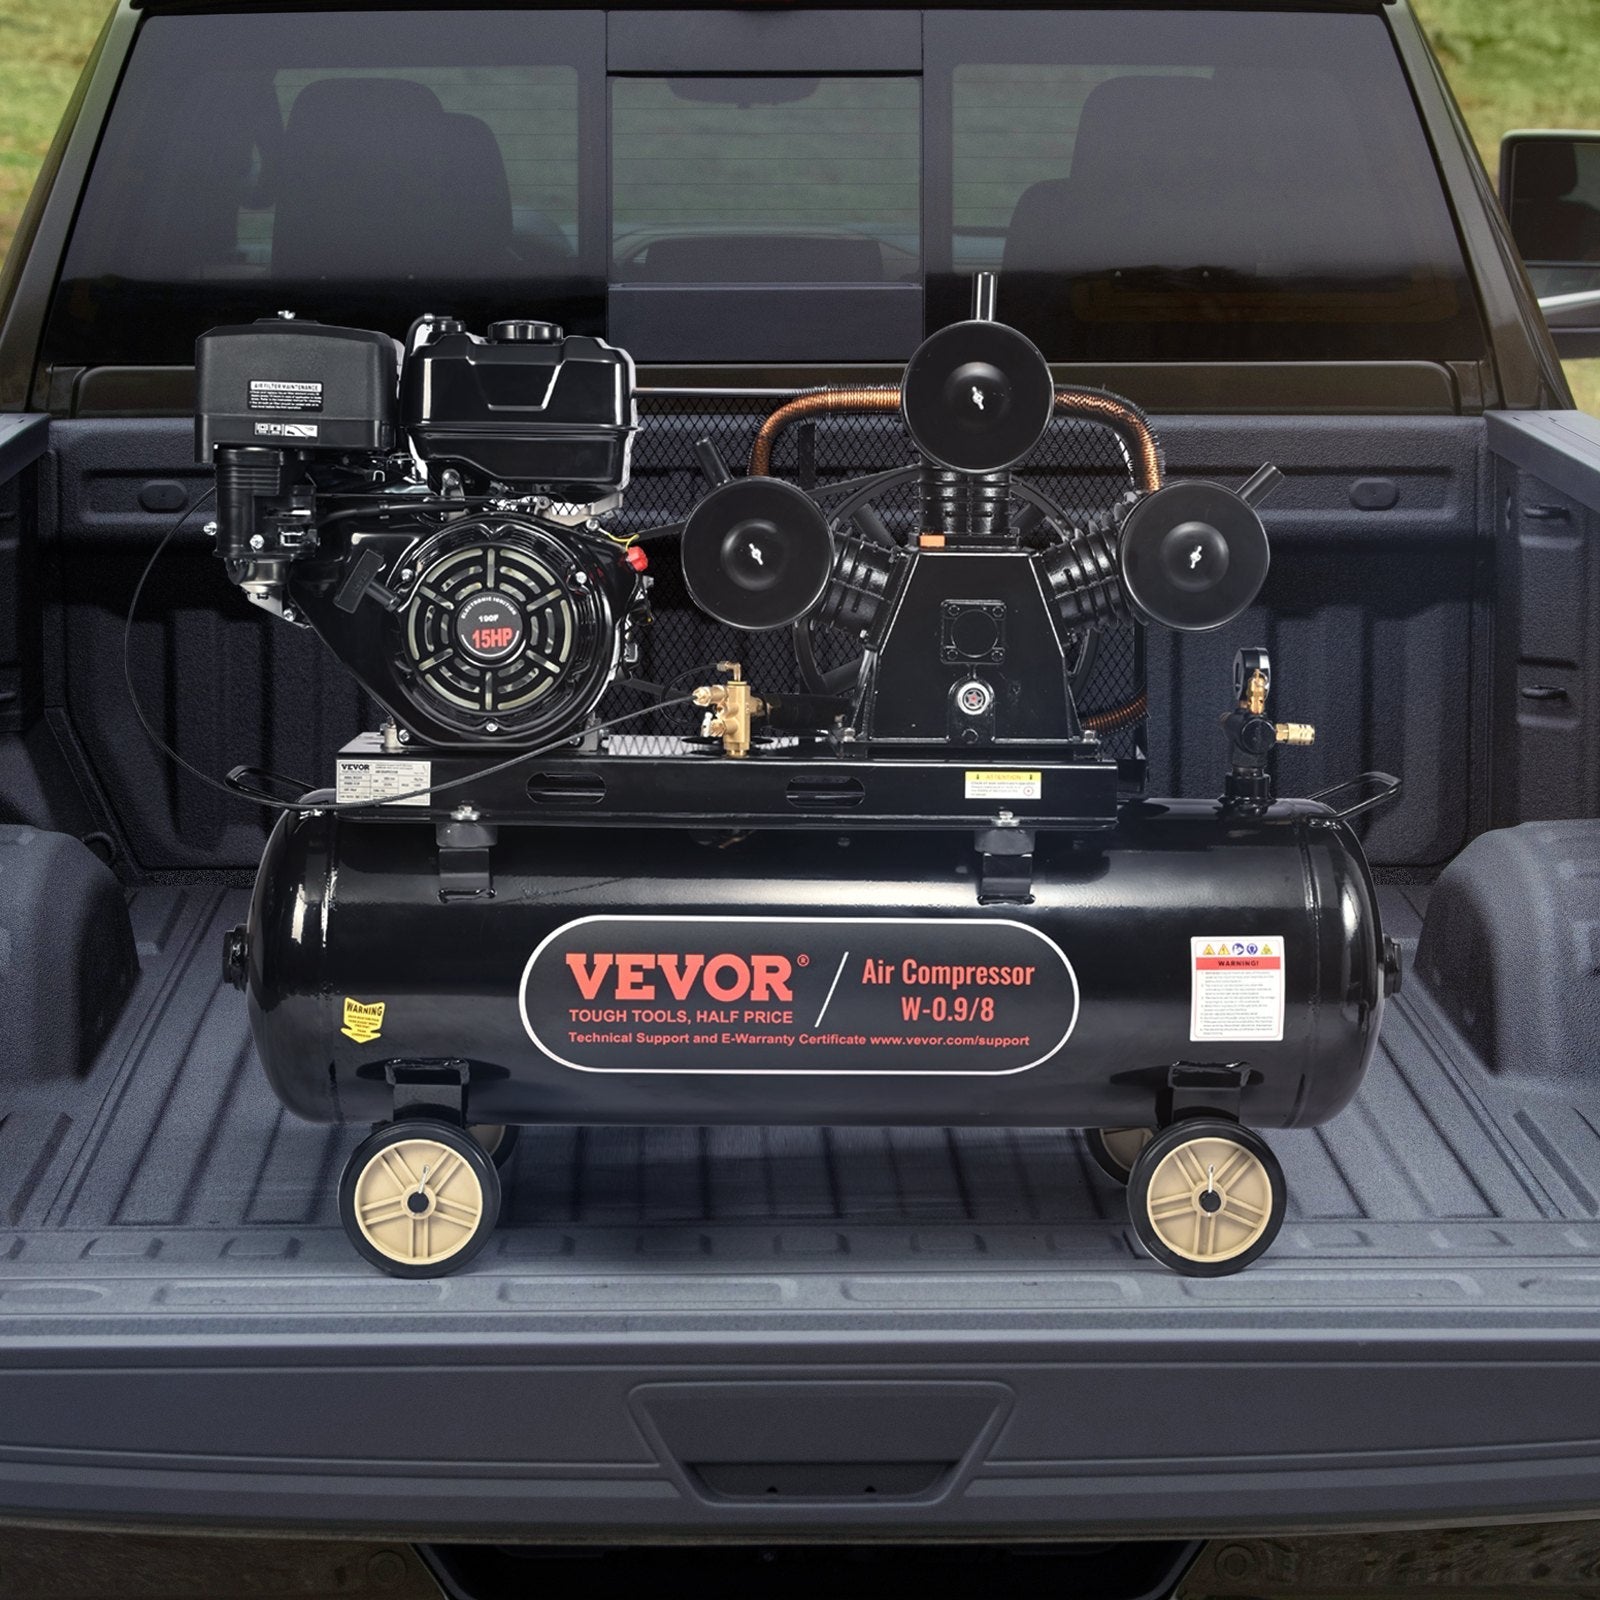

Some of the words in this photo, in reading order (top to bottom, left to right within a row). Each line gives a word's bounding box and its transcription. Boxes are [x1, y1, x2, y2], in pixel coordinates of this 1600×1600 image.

[472, 627, 513, 649] 15HP
[862, 958, 895, 985] Air
[902, 957, 1035, 991] Compressor
[346, 1001, 383, 1017] WARNING
[569, 1008, 628, 1023] TOUGH
[631, 1008, 691, 1025] TOOLS,
[695, 1009, 740, 1023] HALF
[743, 1009, 794, 1024] PRICE
[902, 995, 995, 1023] W-0.9/8
[568, 1031, 633, 1043] Technical
[636, 1032, 690, 1046] Support
[693, 1033, 719, 1044] and
[720, 1033, 795, 1047] E-Warranty
[798, 1033, 867, 1045] Certificate
[869, 1035, 1030, 1048] www.vevor.com/support
